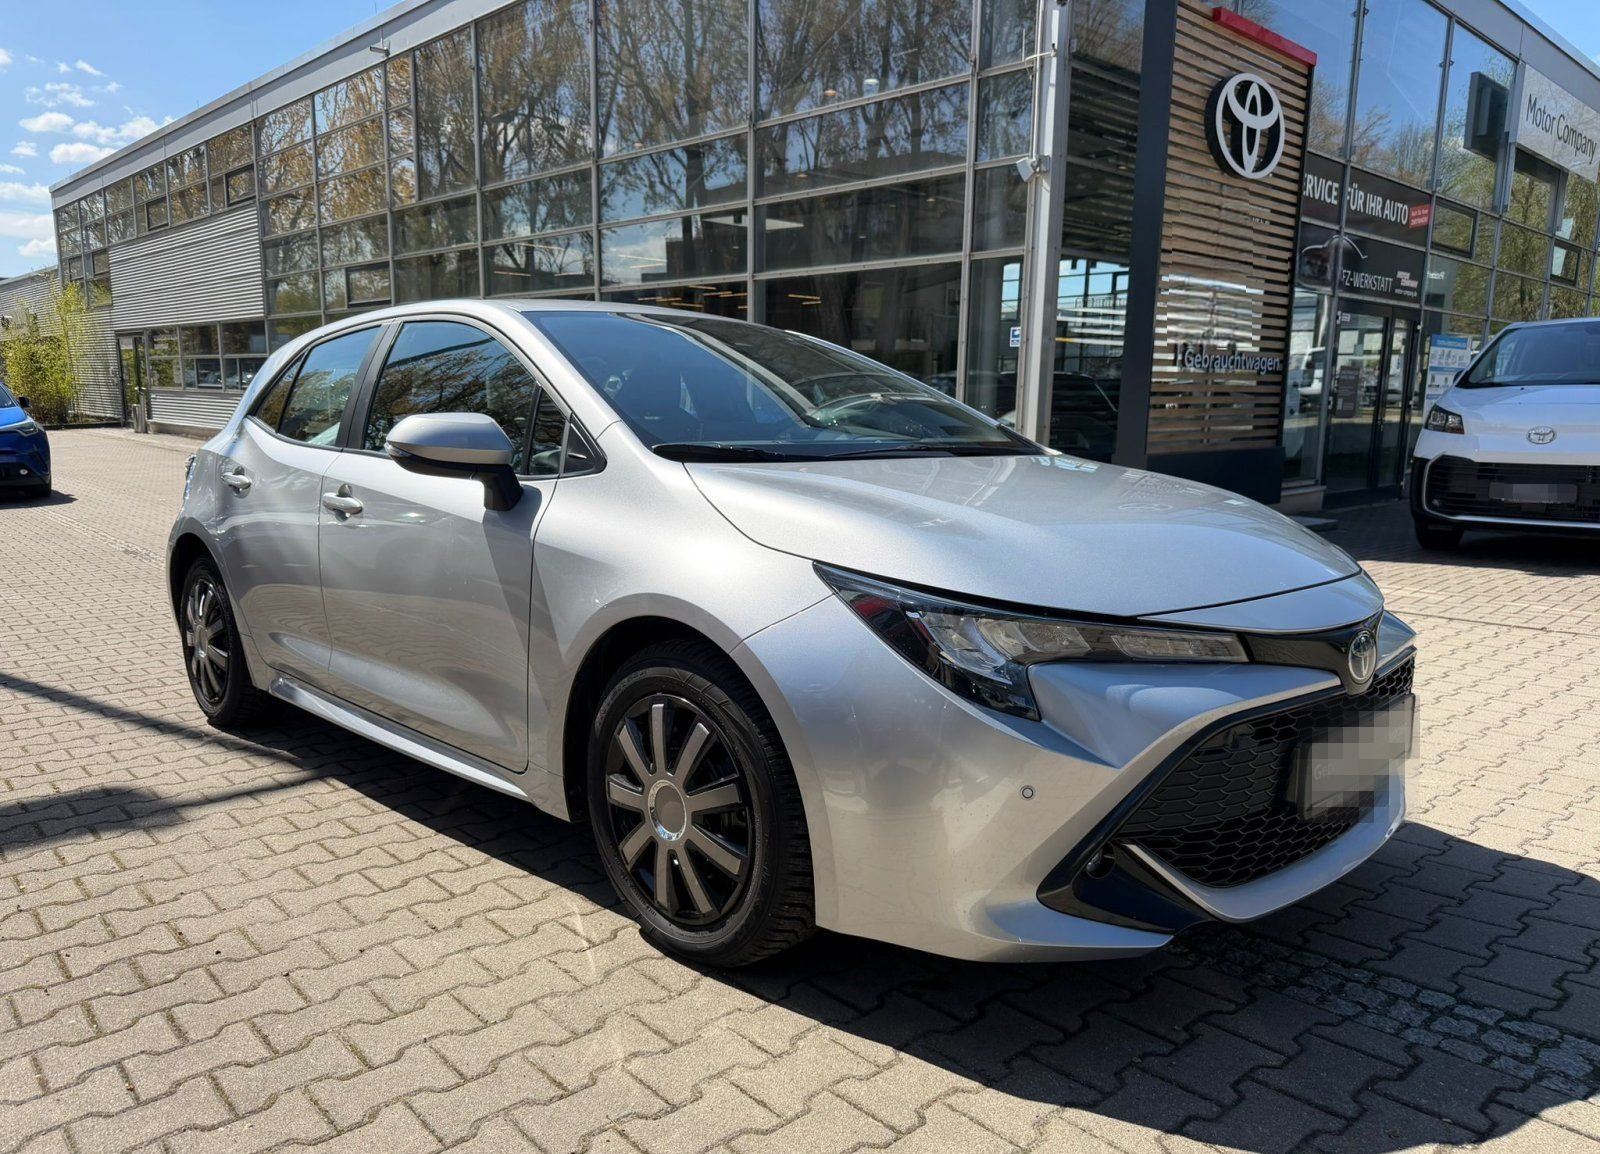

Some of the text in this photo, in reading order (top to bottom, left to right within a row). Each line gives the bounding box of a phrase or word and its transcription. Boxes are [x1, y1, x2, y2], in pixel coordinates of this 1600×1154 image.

[1526, 94, 1597, 164] Motor Company
[1365, 193, 1382, 217] IHR
[1383, 199, 1408, 225] AUTO
[1184, 347, 1280, 375] Gebrauchtwagen
